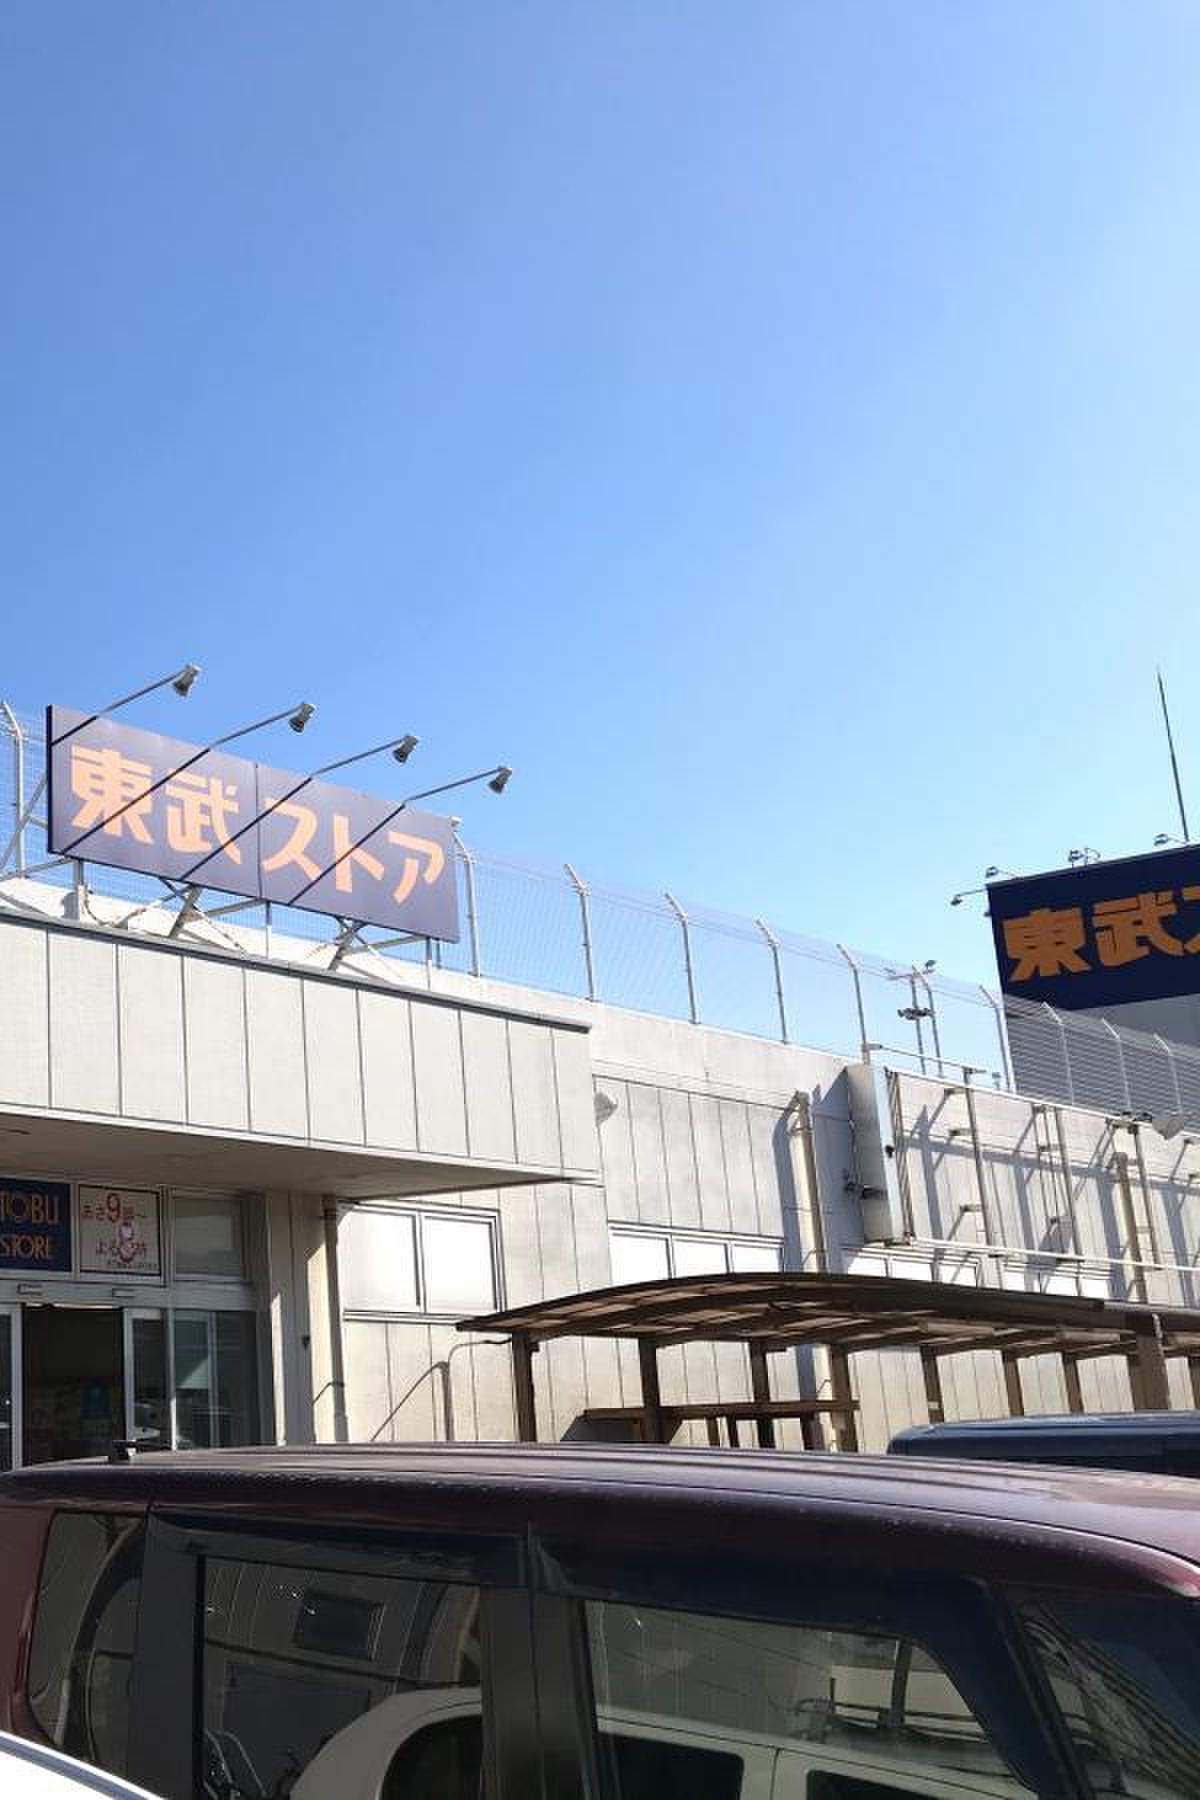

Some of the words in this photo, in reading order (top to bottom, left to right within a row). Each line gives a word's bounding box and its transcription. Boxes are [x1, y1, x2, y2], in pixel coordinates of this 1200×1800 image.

[71, 745, 445, 904] 東武ストア
[0, 1232, 57, 1260] STORE
